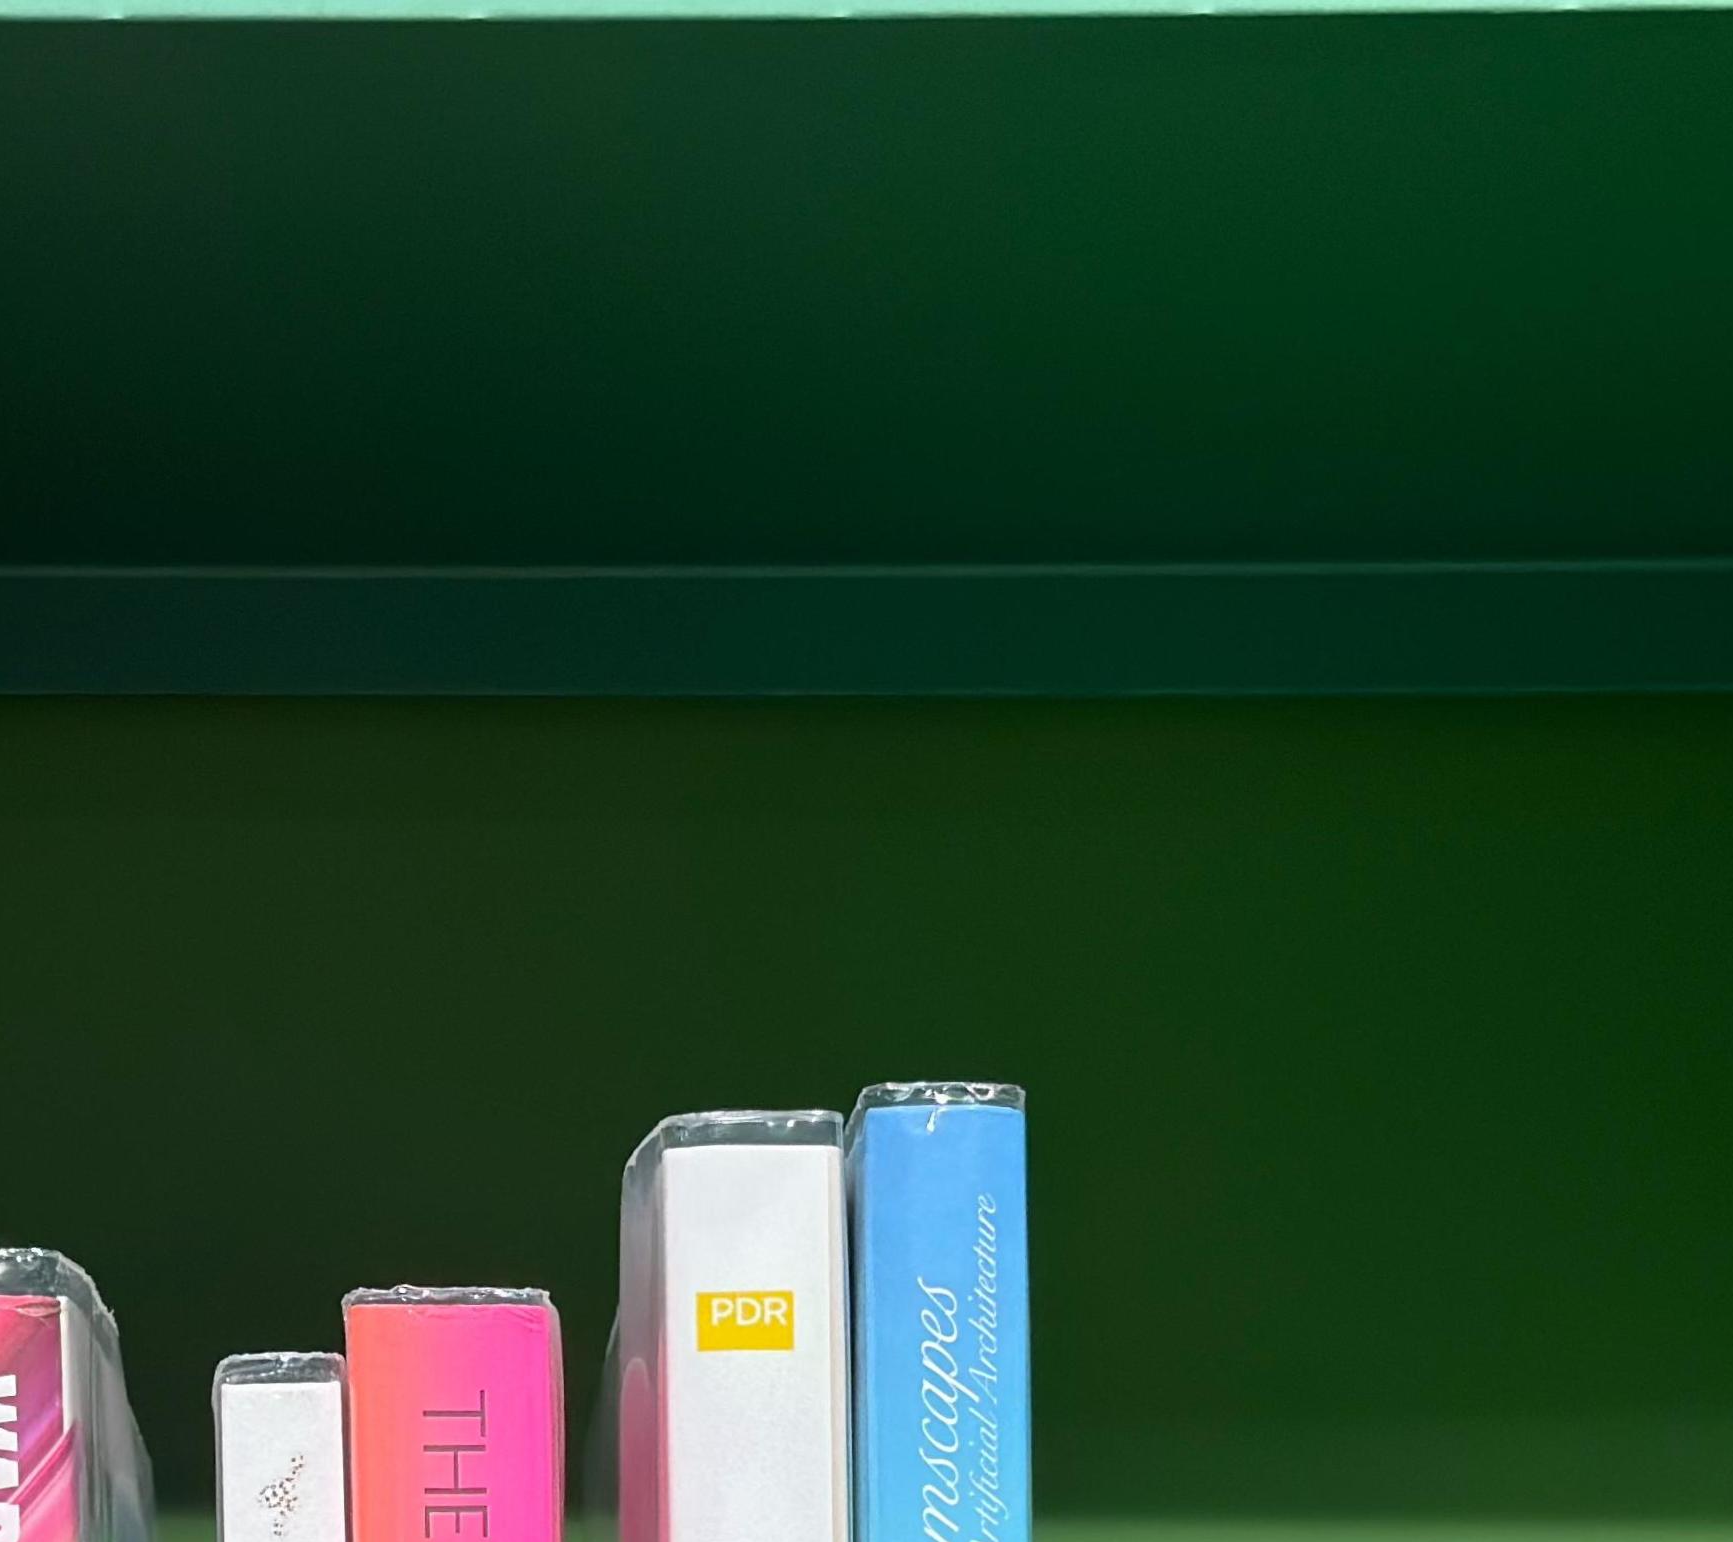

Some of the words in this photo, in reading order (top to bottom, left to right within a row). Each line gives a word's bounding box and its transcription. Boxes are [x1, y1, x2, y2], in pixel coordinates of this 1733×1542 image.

[710, 1297, 789, 1327] PDR
[968, 1193, 998, 1403] Architecture
[423, 1389, 487, 1538] THE
